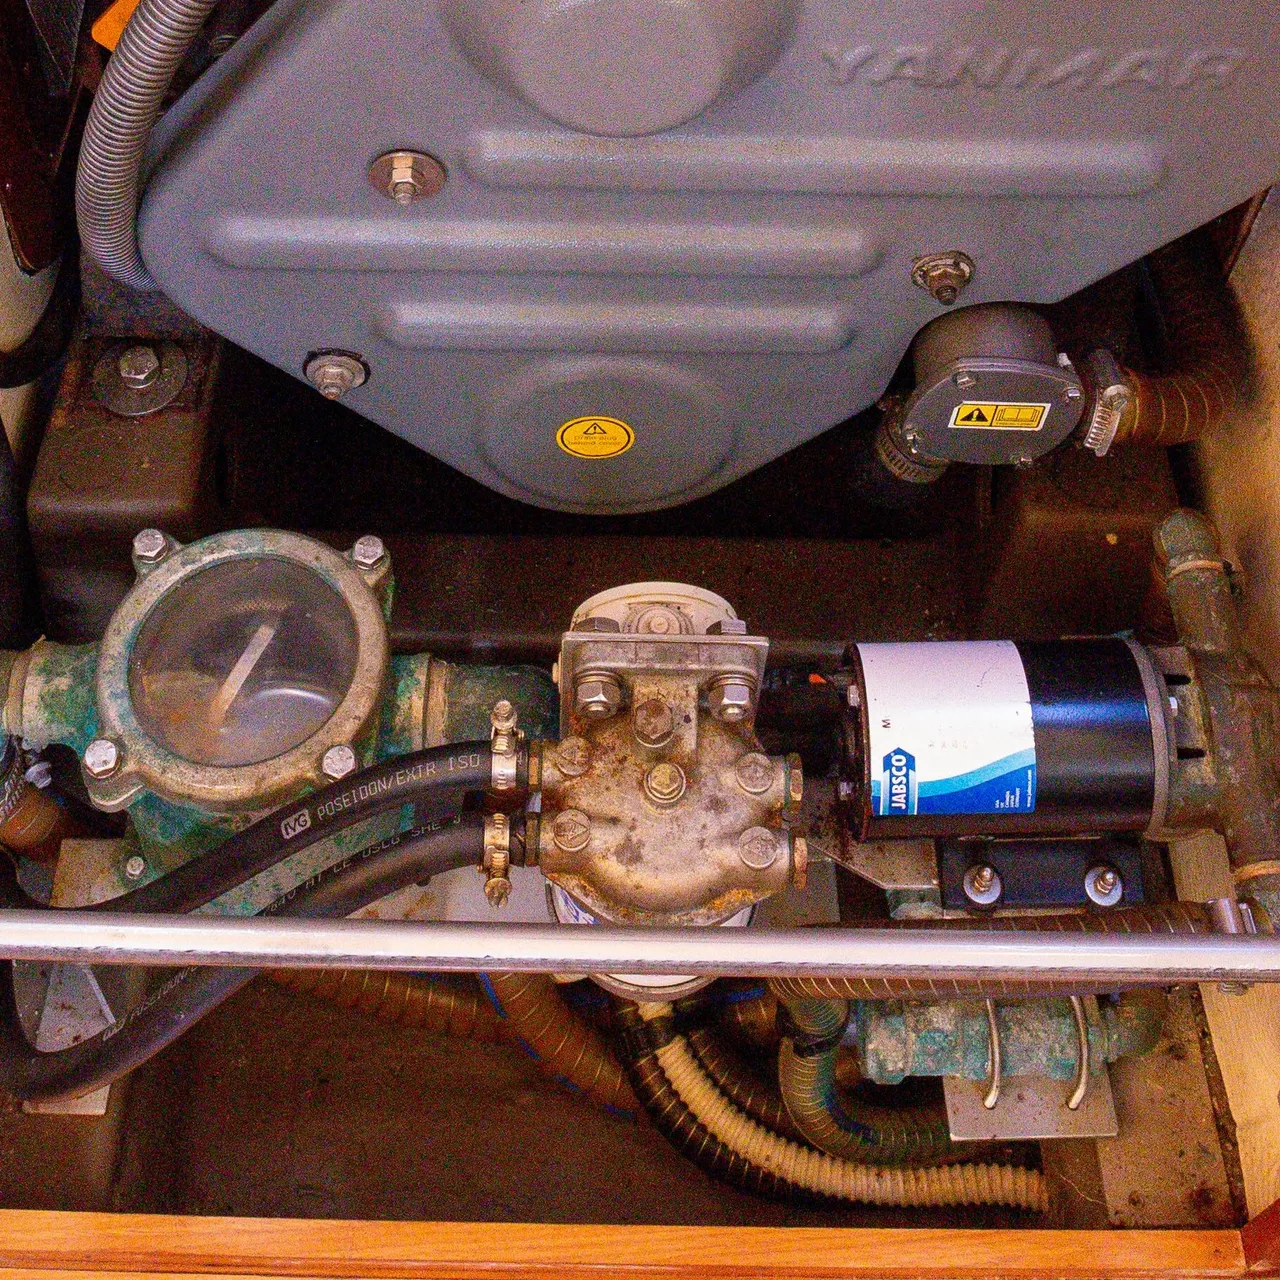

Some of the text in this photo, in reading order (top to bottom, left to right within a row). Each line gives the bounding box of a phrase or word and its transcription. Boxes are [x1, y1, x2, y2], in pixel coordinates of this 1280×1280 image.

[822, 42, 1246, 92] YANMAR
[317, 762, 437, 820] POSEIDON/EXTR
[449, 754, 481, 771] ISO
[891, 754, 906, 809] JABSCO
